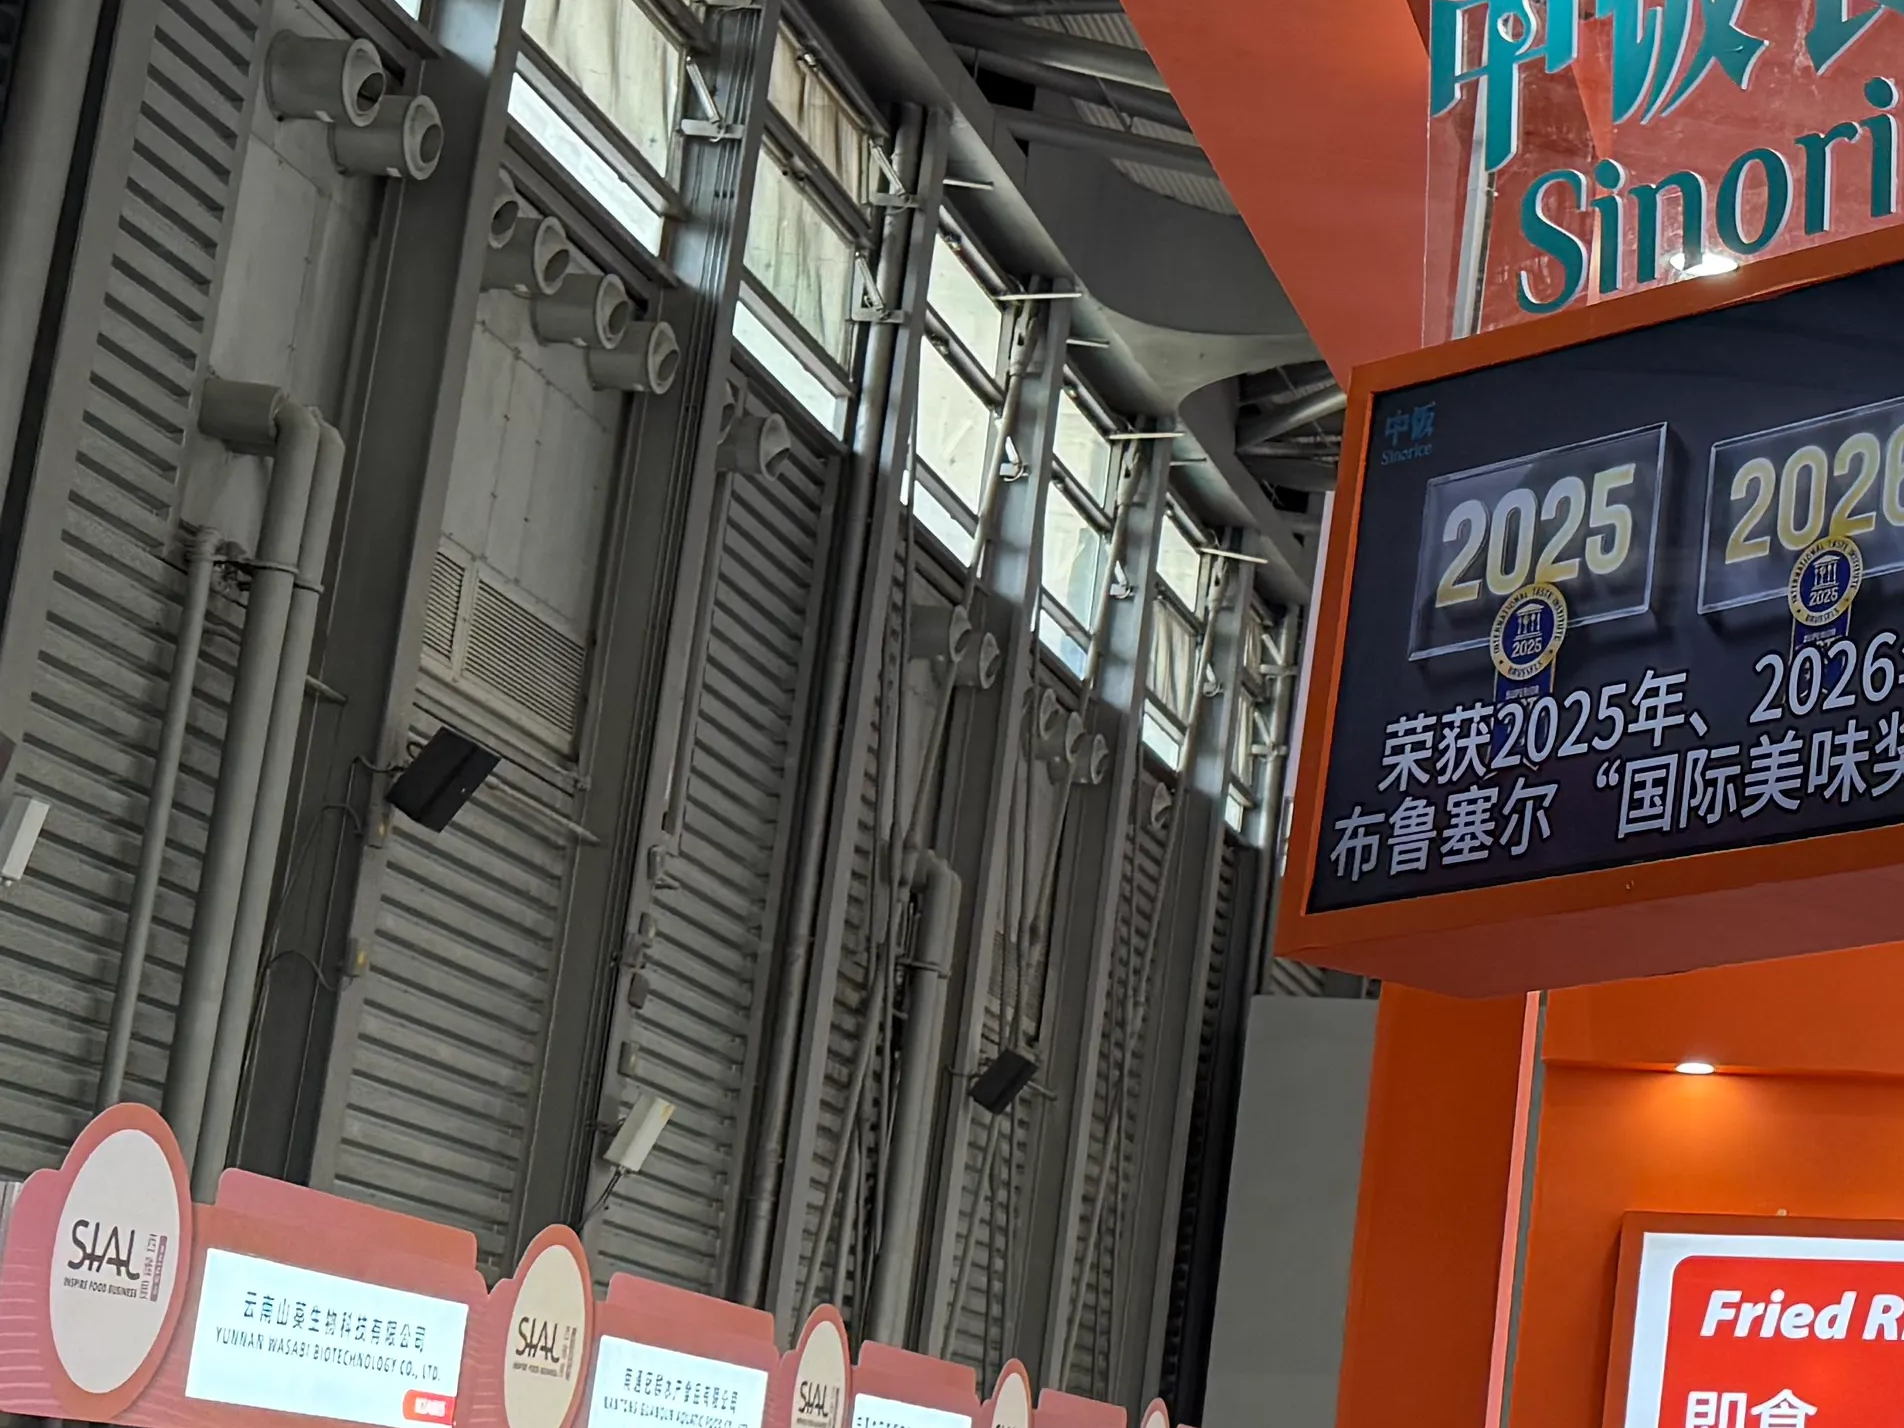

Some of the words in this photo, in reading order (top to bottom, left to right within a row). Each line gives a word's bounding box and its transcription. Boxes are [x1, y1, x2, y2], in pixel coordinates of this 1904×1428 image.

[1434, 462, 1637, 608] 2025
[68, 1219, 140, 1280] SIAL
[516, 1316, 560, 1363] SIAL
[1701, 1289, 1855, 1342] Fried
[216, 1326, 263, 1350] YUNNAN
[268, 1336, 310, 1358] WASABI
[313, 1343, 397, 1373] BIOTECHNOLOGY
[798, 1380, 829, 1418] SIAL
